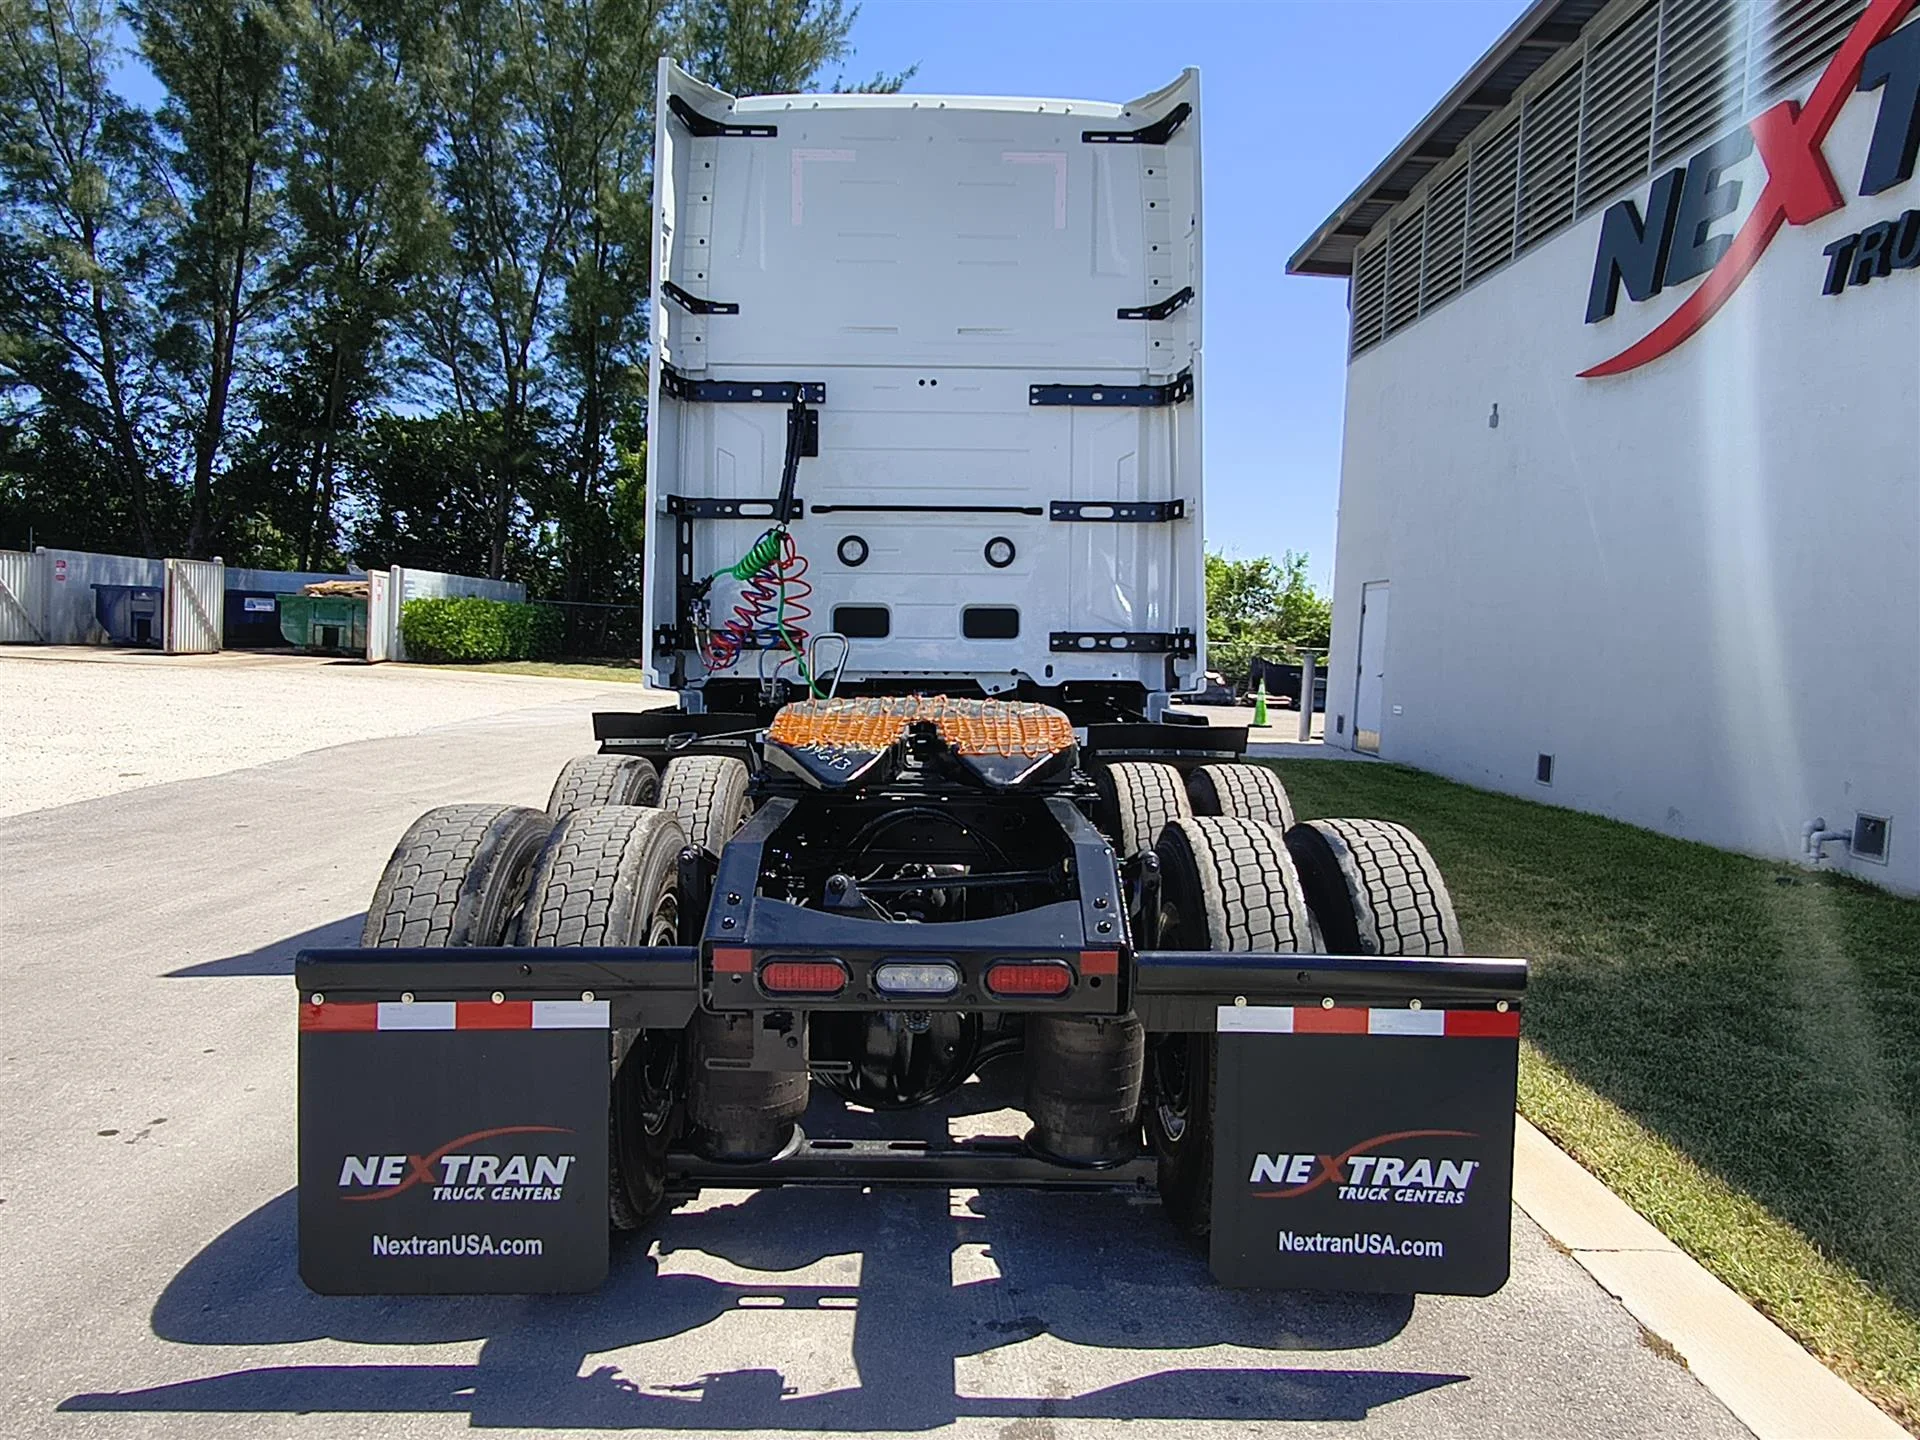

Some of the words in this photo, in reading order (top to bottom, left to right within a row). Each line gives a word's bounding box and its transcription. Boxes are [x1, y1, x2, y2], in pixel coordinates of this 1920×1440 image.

[338, 1155, 571, 1186] NEXTRAN
[1249, 1154, 1474, 1189] NEXTRAN
[432, 1187, 485, 1200] TRUCK
[491, 1187, 562, 1200] CENTERS
[1338, 1186, 1388, 1201] TRUCK
[1394, 1188, 1465, 1204] CENTERS
[373, 1235, 543, 1256] NextranUSA.com
[1278, 1230, 1444, 1257] NextranUSA.com
